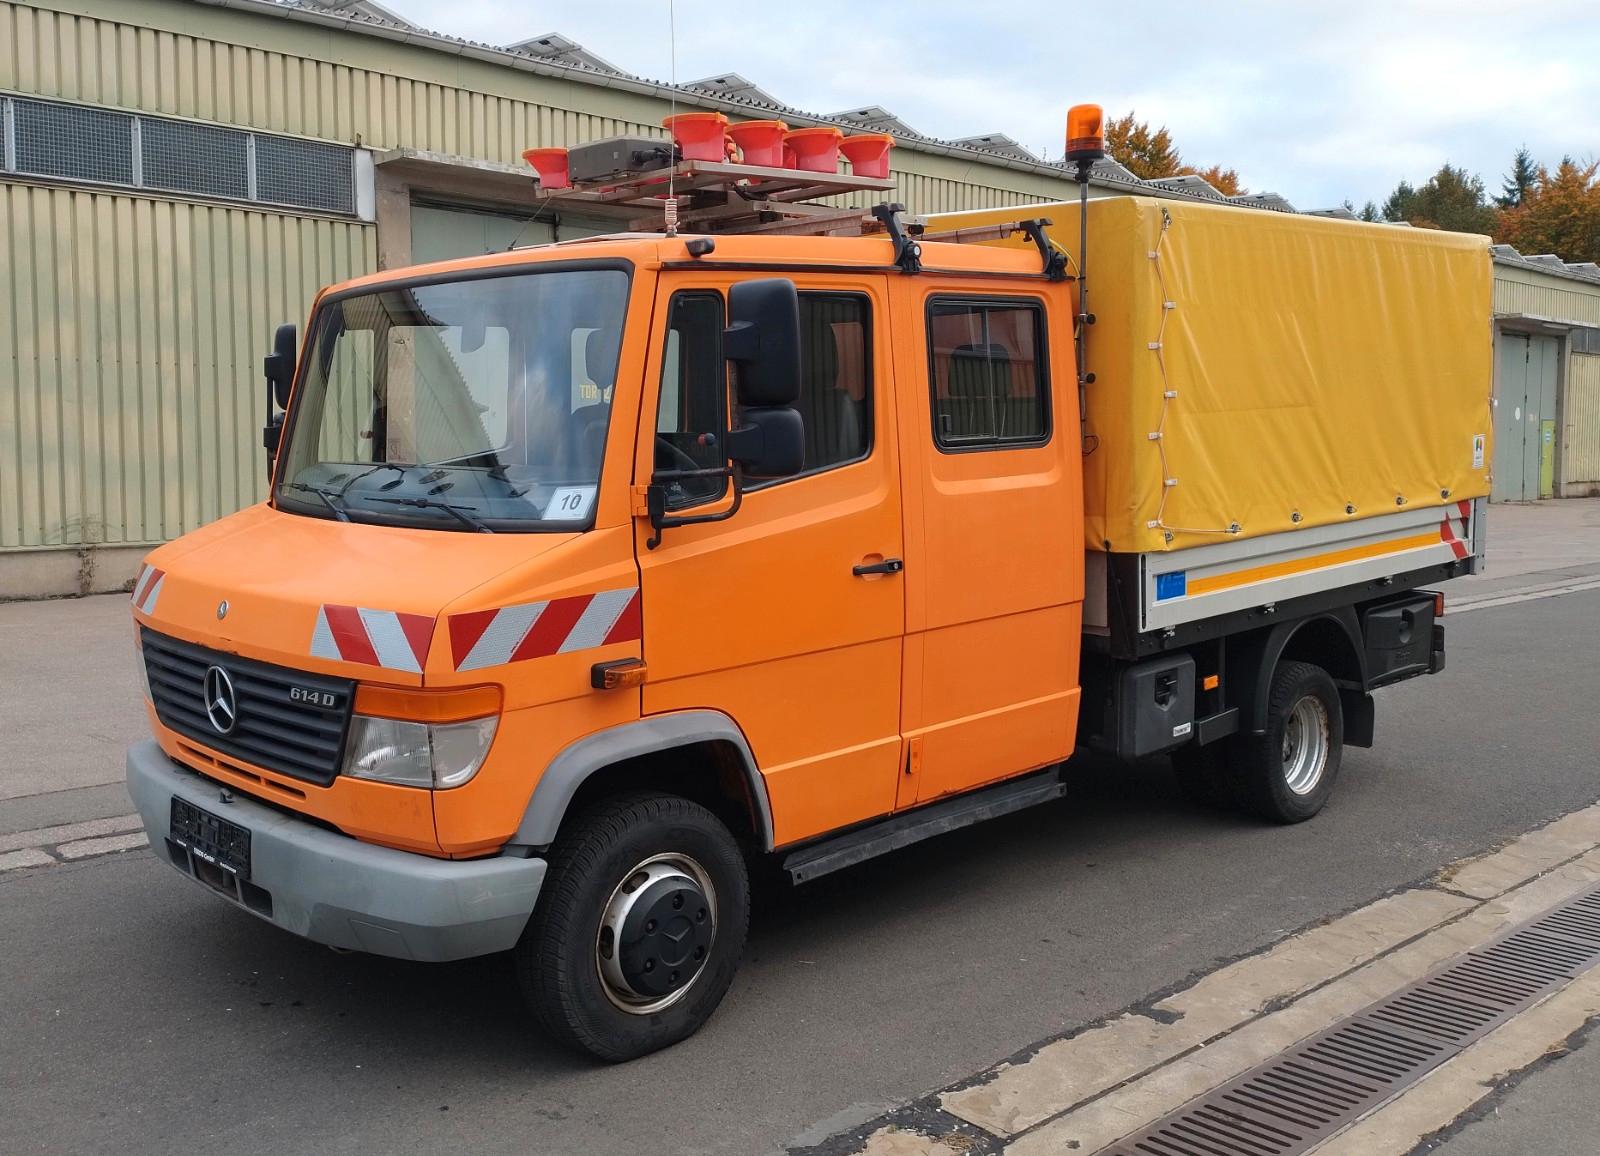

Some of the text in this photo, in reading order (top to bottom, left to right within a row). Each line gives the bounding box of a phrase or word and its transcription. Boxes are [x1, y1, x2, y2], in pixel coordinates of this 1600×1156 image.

[561, 494, 582, 510] 10
[290, 687, 335, 706] 614 D
